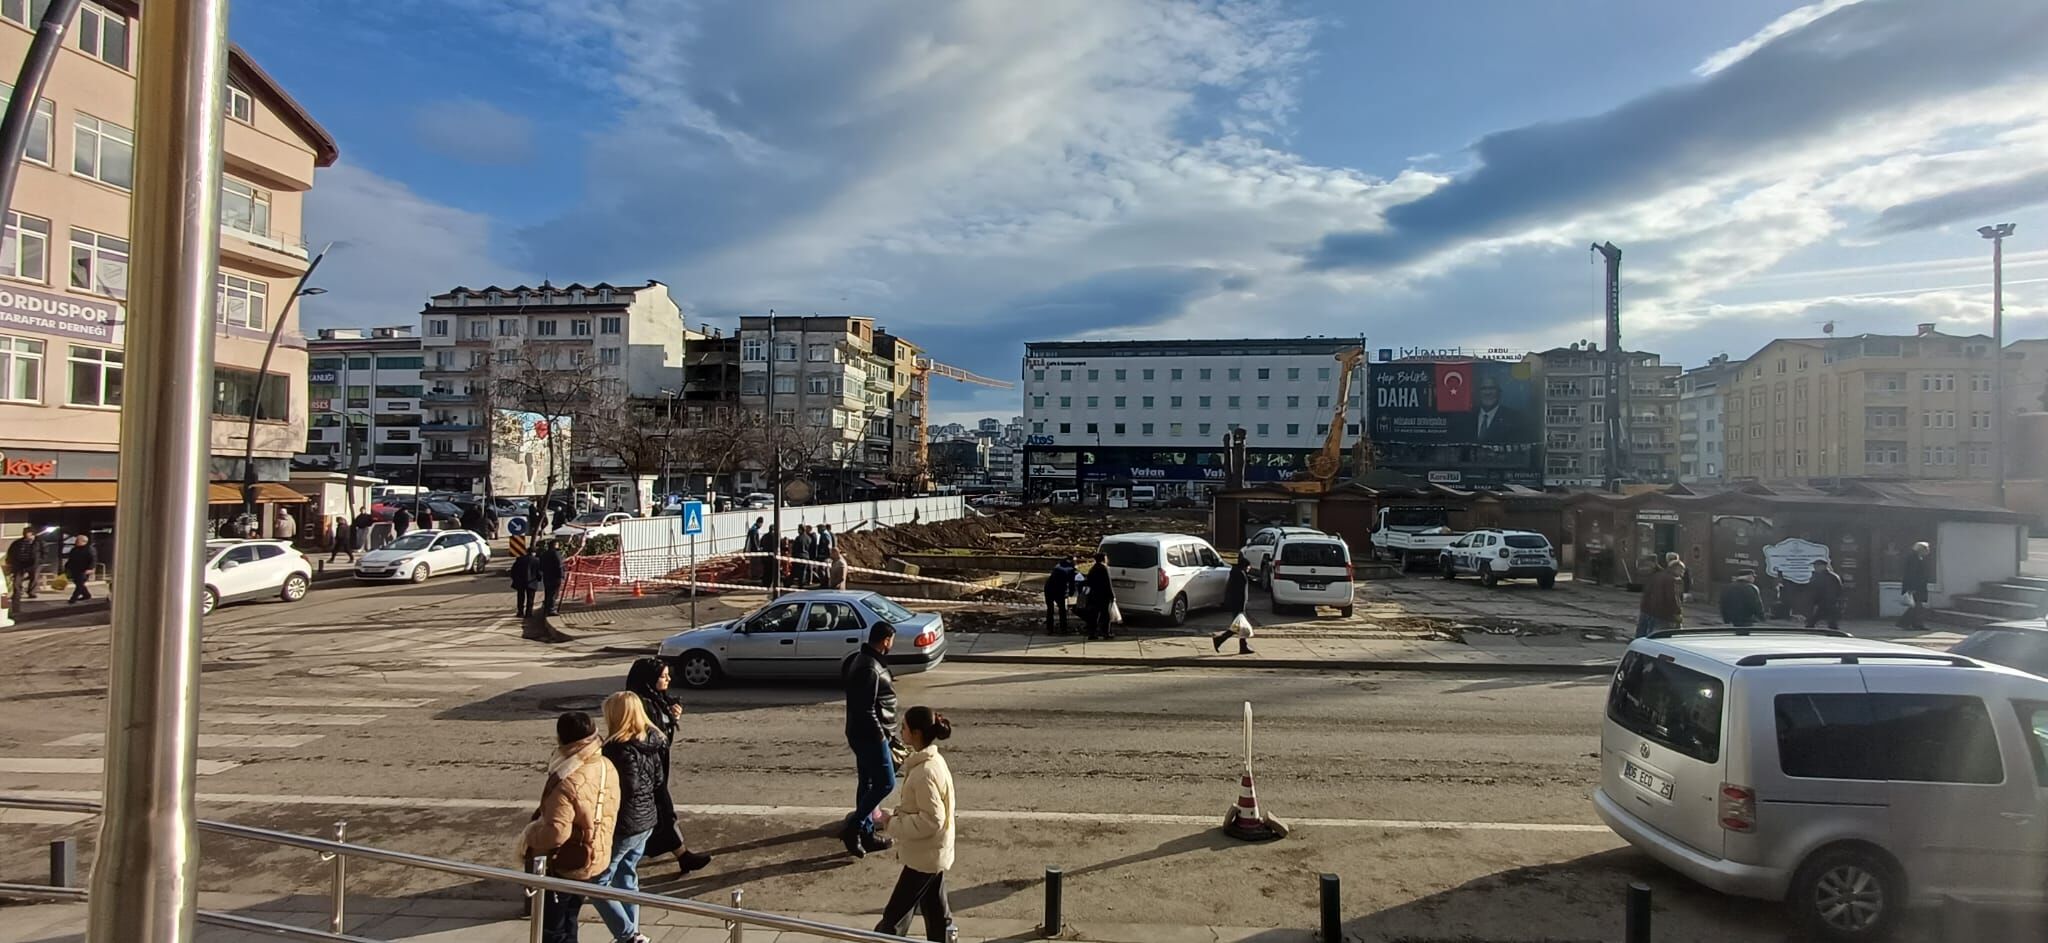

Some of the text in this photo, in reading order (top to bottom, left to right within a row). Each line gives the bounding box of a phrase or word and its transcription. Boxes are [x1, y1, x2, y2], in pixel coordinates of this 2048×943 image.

[0, 291, 108, 324] ORDUSPOR
[0, 312, 56, 328] TARAFTAR
[1378, 387, 1419, 408] DAHA
[1130, 467, 1165, 477] Vatan
[1660, 782, 1671, 796] 25
